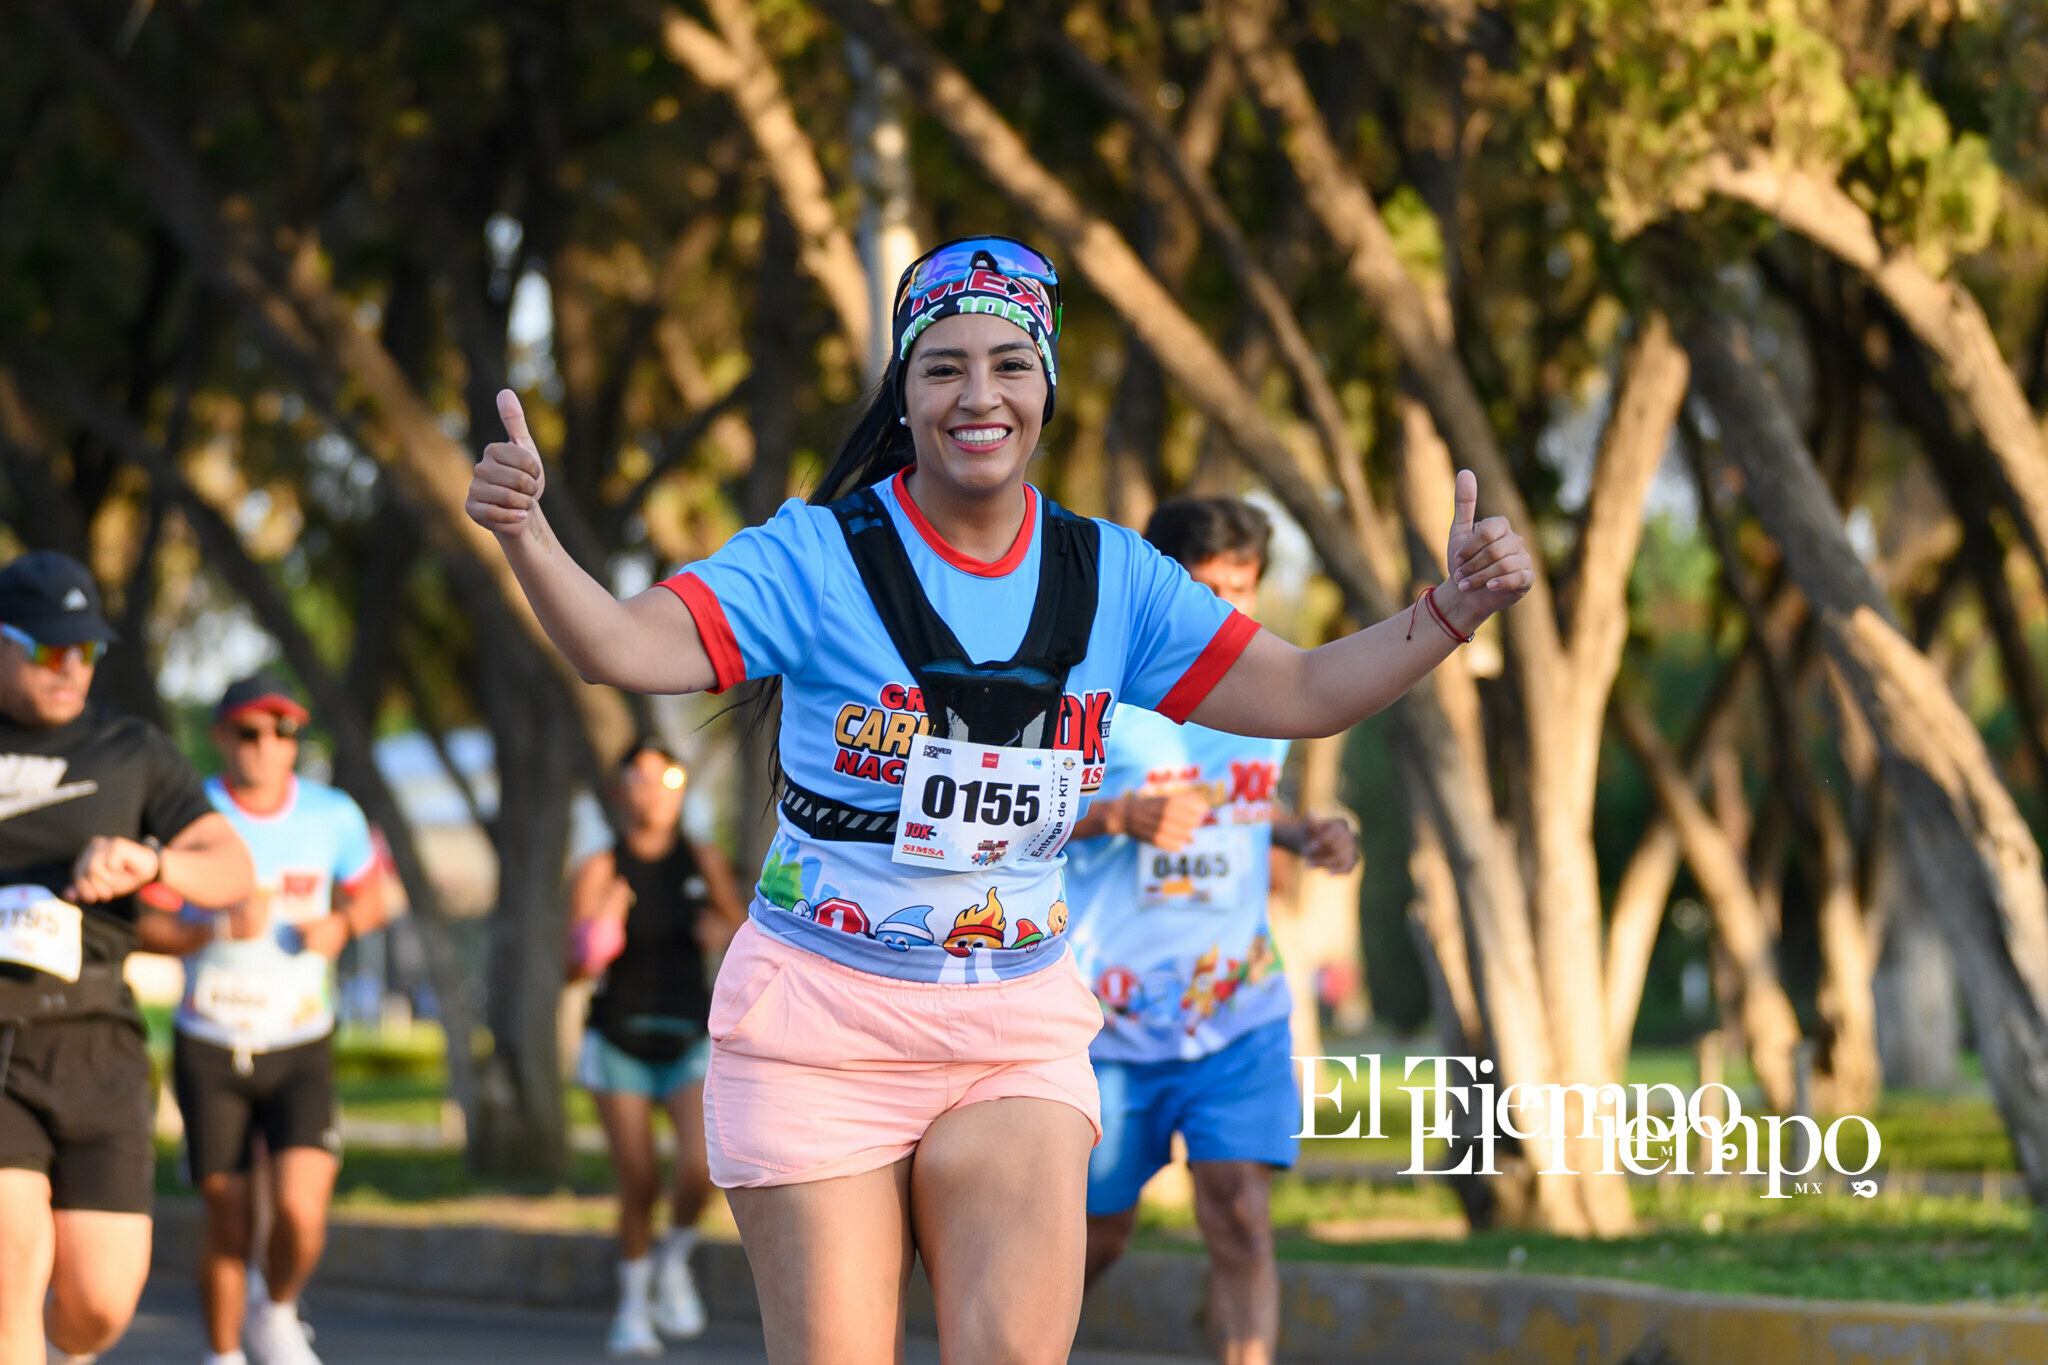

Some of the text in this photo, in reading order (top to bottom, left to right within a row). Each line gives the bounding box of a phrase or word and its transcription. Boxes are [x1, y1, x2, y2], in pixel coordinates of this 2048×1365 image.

[834, 748, 908, 785] NAC
[1081, 766, 1106, 785] MS
[921, 774, 1041, 827] 0155
[1030, 775, 1069, 858] Entrega de KIT
[904, 822, 937, 841] 10K
[902, 844, 945, 857] SIMSA
[1153, 853, 1230, 879] 0465
